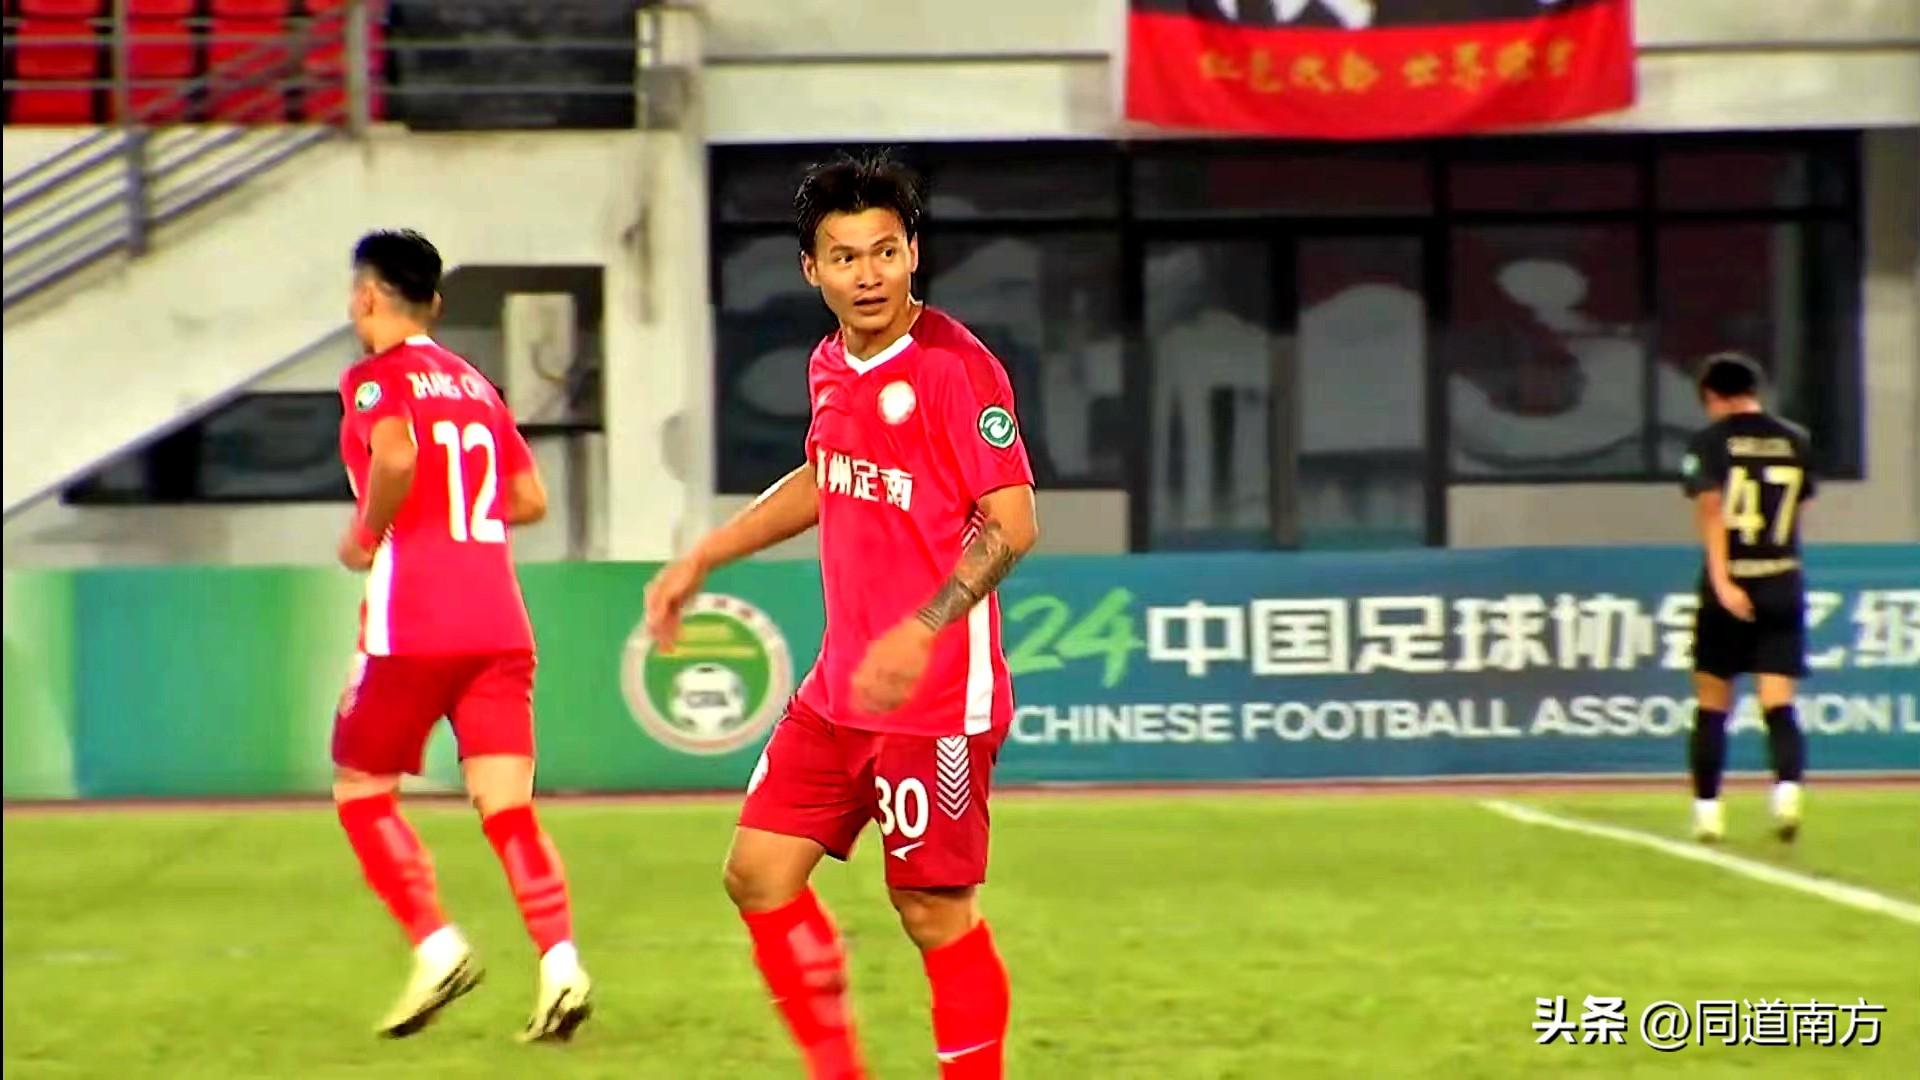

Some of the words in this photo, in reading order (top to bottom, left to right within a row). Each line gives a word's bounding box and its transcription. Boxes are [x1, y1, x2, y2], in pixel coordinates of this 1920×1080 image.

[432, 420, 506, 542] 12
[1722, 465, 1803, 546] 47
[1013, 703, 1232, 742] CHINESE
[1243, 696, 1522, 739] FOOTBALL
[875, 775, 929, 838] 30
